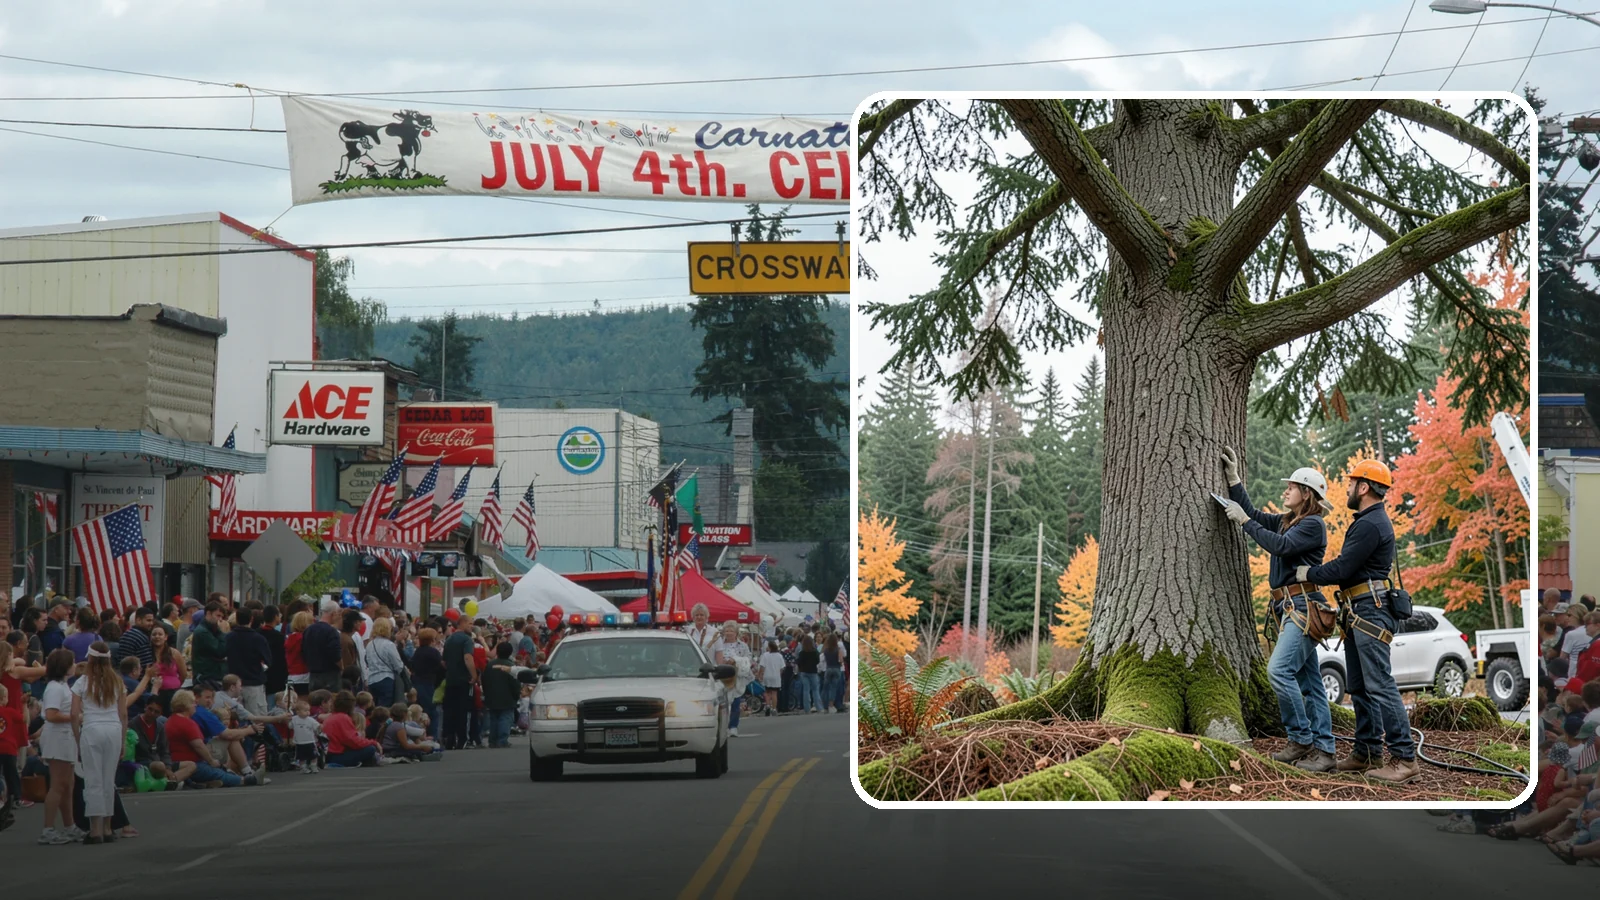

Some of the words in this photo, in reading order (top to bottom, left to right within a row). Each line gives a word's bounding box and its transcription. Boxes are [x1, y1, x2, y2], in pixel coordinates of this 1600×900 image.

[481, 141, 605, 193] JULY
[632, 150, 746, 198] 4th.
[696, 253, 850, 280] CROSSWA
[282, 380, 374, 420] ACE
[406, 409, 452, 422] CEDAR
[460, 409, 485, 422] LOG
[283, 421, 371, 436] Hardware
[416, 428, 476, 447] Coca-Cola
[353, 467, 384, 480] Simpl
[96, 485, 124, 495] Vincent
[126, 486, 136, 495] de
[138, 486, 155, 495] Paul
[688, 527, 741, 535] CRNATION
[699, 535, 730, 543] GLASS
